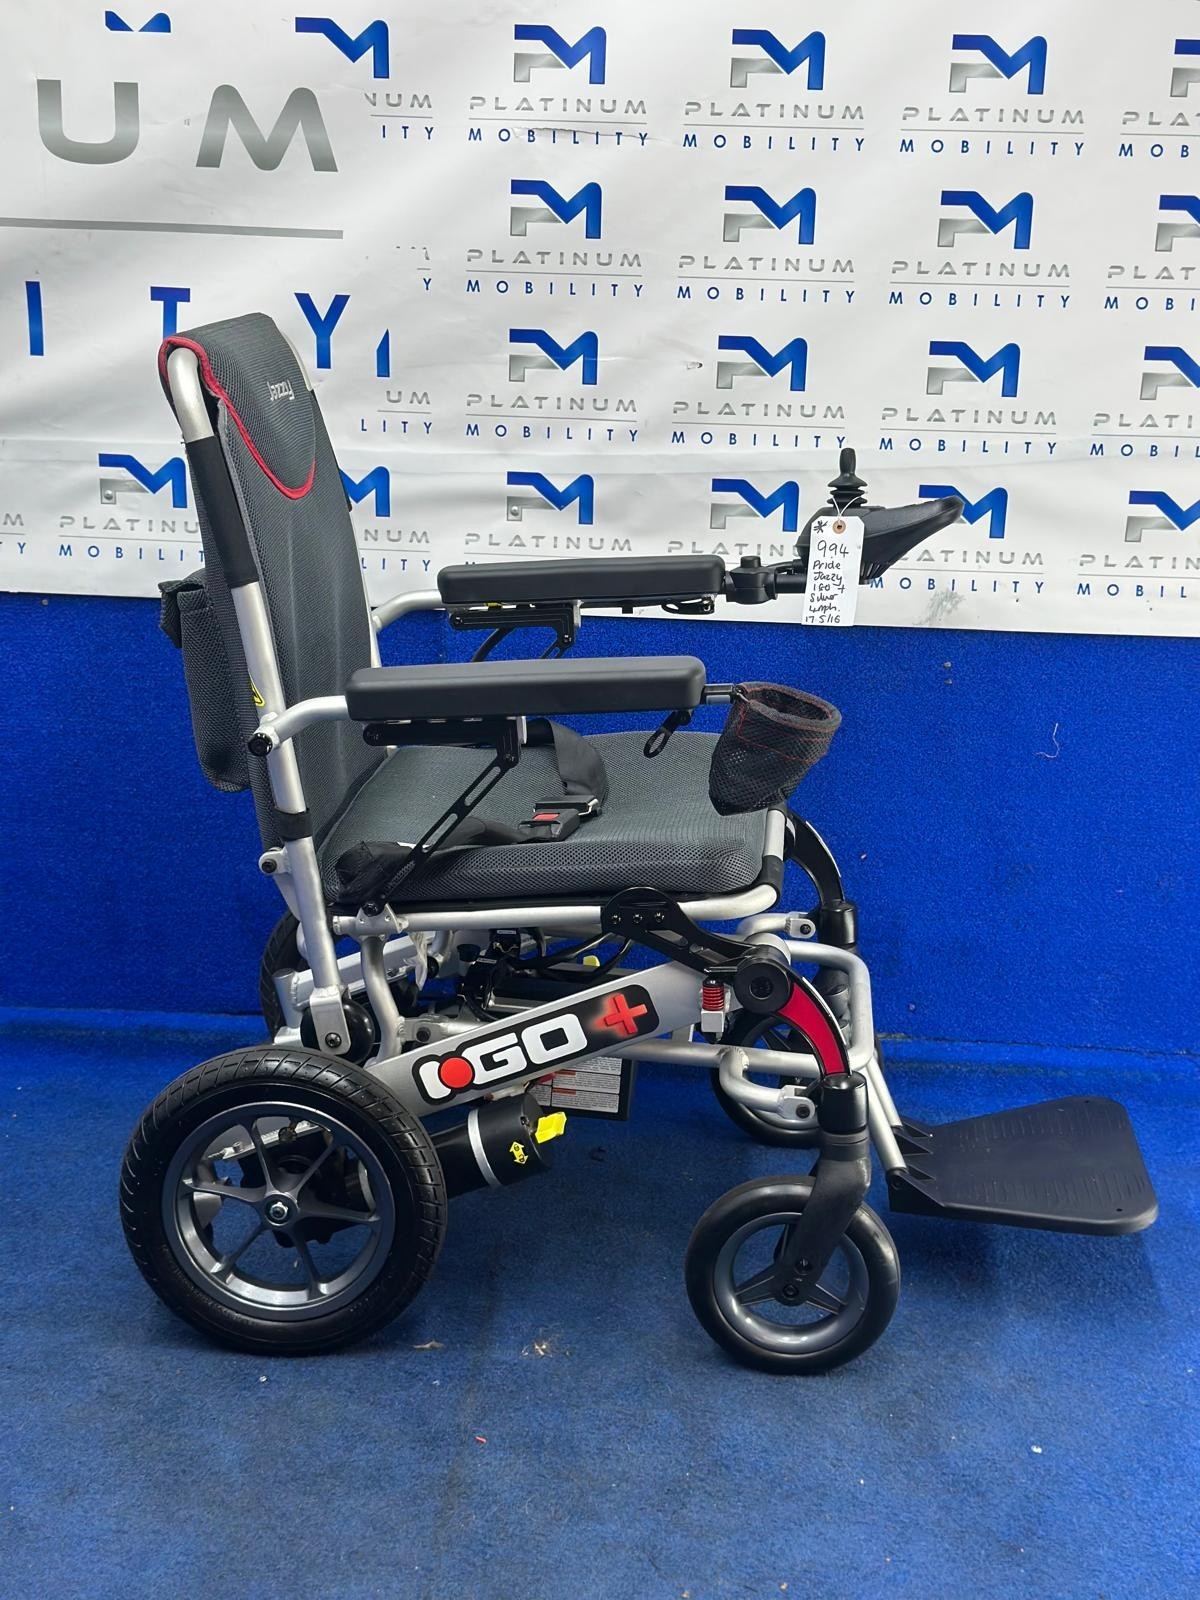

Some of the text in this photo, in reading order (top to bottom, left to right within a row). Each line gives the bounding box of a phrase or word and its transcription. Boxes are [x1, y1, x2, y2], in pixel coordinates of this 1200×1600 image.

[470, 96, 646, 114] PLATINUM
[685, 102, 864, 120] PLATINUM
[902, 107, 1084, 124] PLATINUM
[1122, 111, 1200, 126] PLA
[383, 125, 433, 140] ITY
[468, 128, 647, 146] MOBILITY
[683, 134, 864, 151] MOBILITY
[900, 139, 1084, 155] MOBILITY
[467, 249, 641, 267] PLATINUM
[679, 255, 854, 273] PLATINUM
[892, 261, 1069, 277] PLATINUM
[1108, 265, 1196, 280] PLAT
[467, 280, 643, 297] MOBILITY
[677, 286, 854, 303] MOBILITY
[889, 292, 1069, 308] MOBILITY
[1104, 296, 1195, 311] MOBI
[467, 394, 636, 412] PLATINUM
[673, 401, 844, 419] PLATINUM
[882, 408, 1056, 425] PLATINUM
[1093, 413, 1192, 428] PLATI
[361, 419, 432, 434] LITY
[466, 424, 637, 442] MOBILITY
[672, 431, 845, 448] MOBILITY
[879, 438, 1056, 454] MOBILITY
[465, 530, 636, 551] PLATINUM
[668, 541, 801, 557] PLATIN
[812, 560, 841, 570] Pride
[900, 549, 1043, 566] ATINUM
[870, 578, 1045, 594] MOBILITY
[1077, 583, 1187, 598] MOBIL
